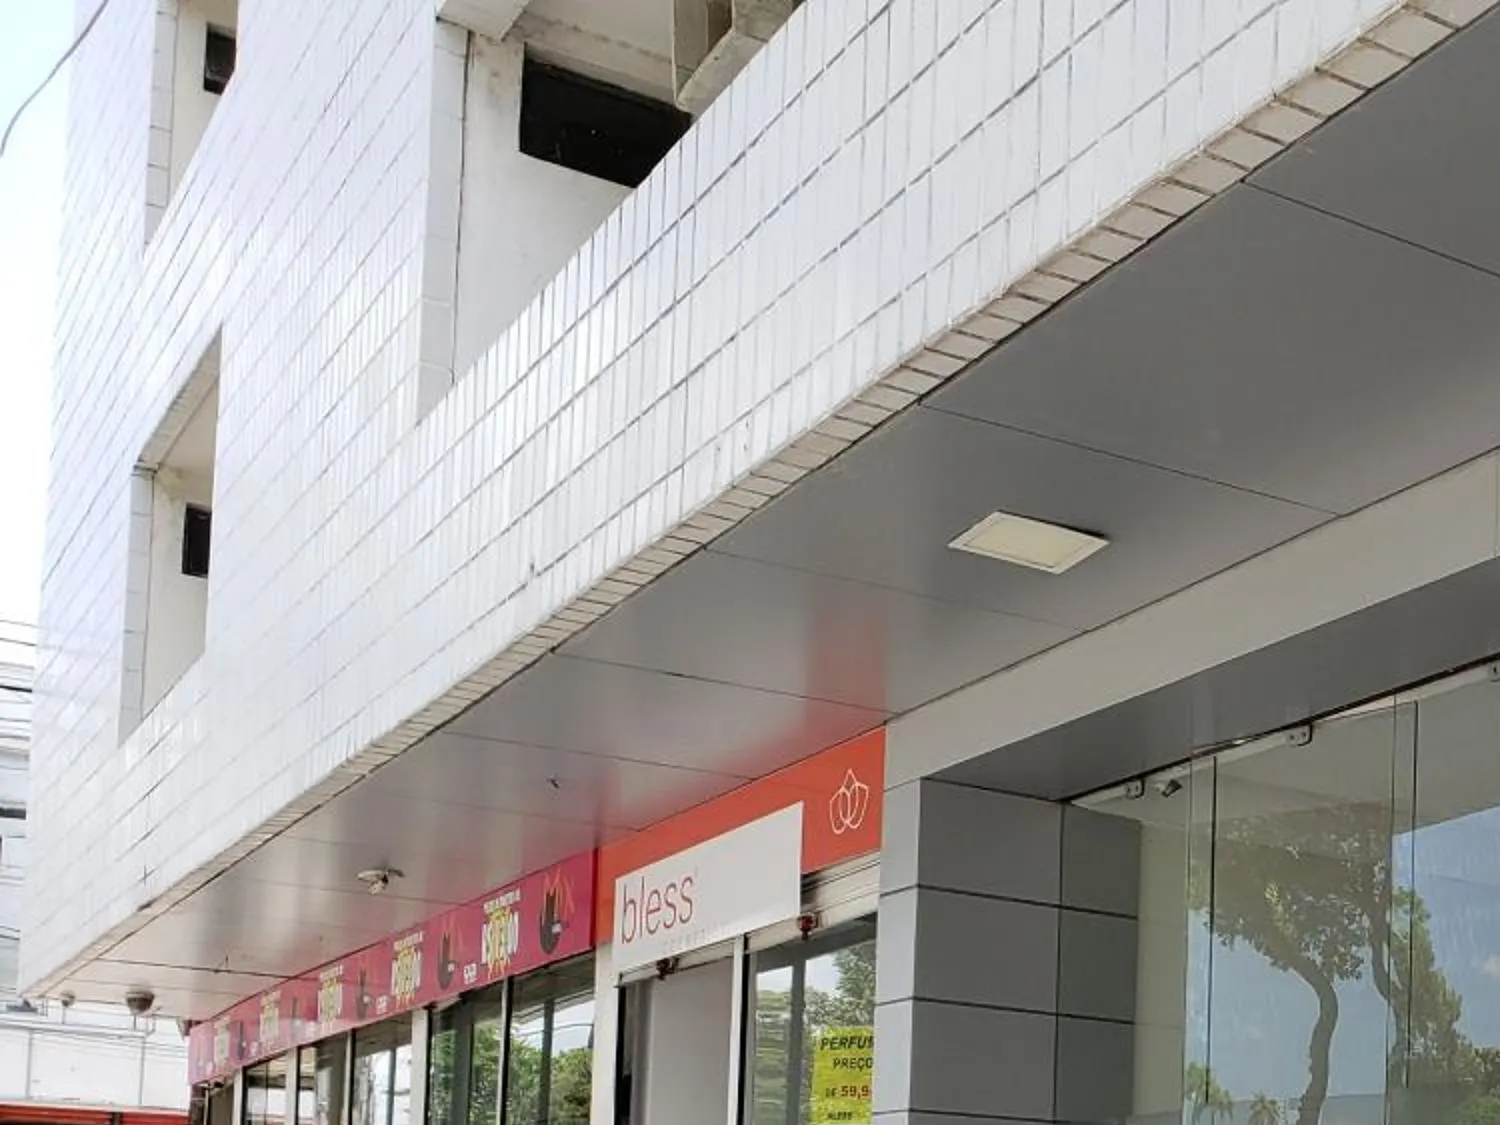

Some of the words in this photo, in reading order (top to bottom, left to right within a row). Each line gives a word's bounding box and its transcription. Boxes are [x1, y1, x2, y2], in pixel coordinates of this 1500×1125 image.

[621, 875, 694, 944] bless
[833, 1057, 873, 1072] PREÇO
[841, 1085, 872, 1099] 59,9
